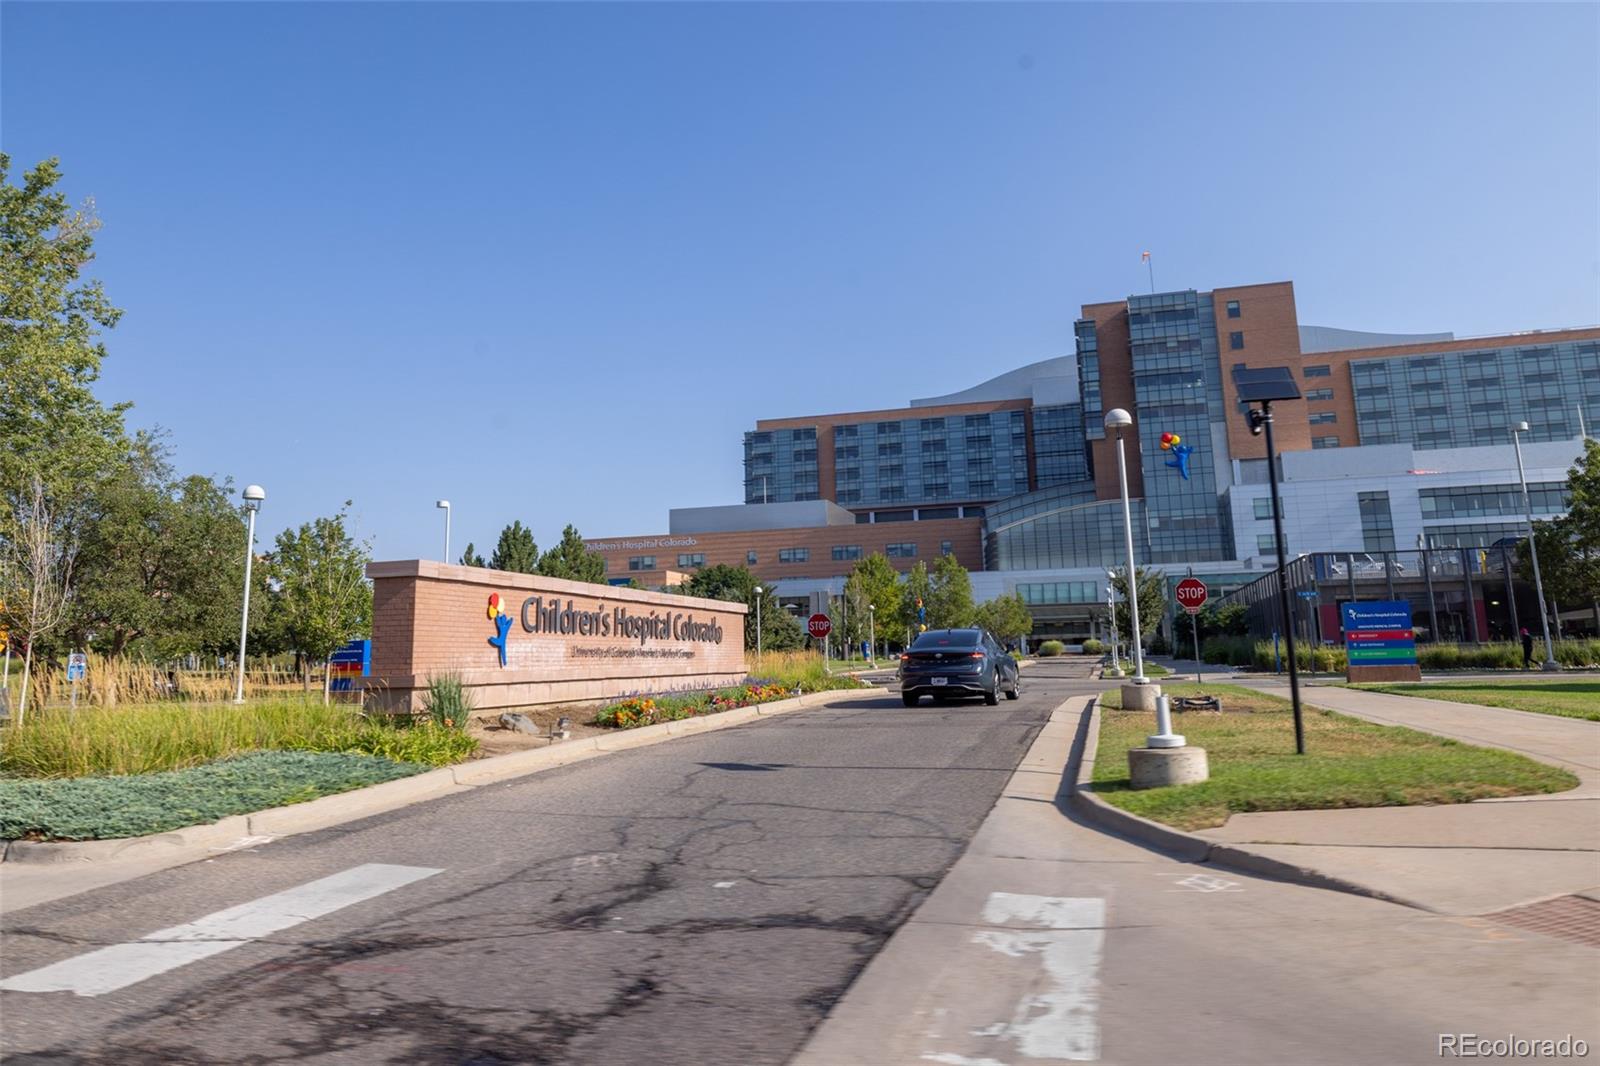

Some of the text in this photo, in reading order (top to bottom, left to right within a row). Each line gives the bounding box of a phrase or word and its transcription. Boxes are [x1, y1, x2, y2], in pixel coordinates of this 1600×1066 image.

[622, 540, 657, 550] Hospital
[659, 537, 697, 547] Colorado
[1178, 587, 1205, 600] STOP
[521, 596, 723, 645] Children's Hospital Colorado
[809, 621, 830, 631] STOP
